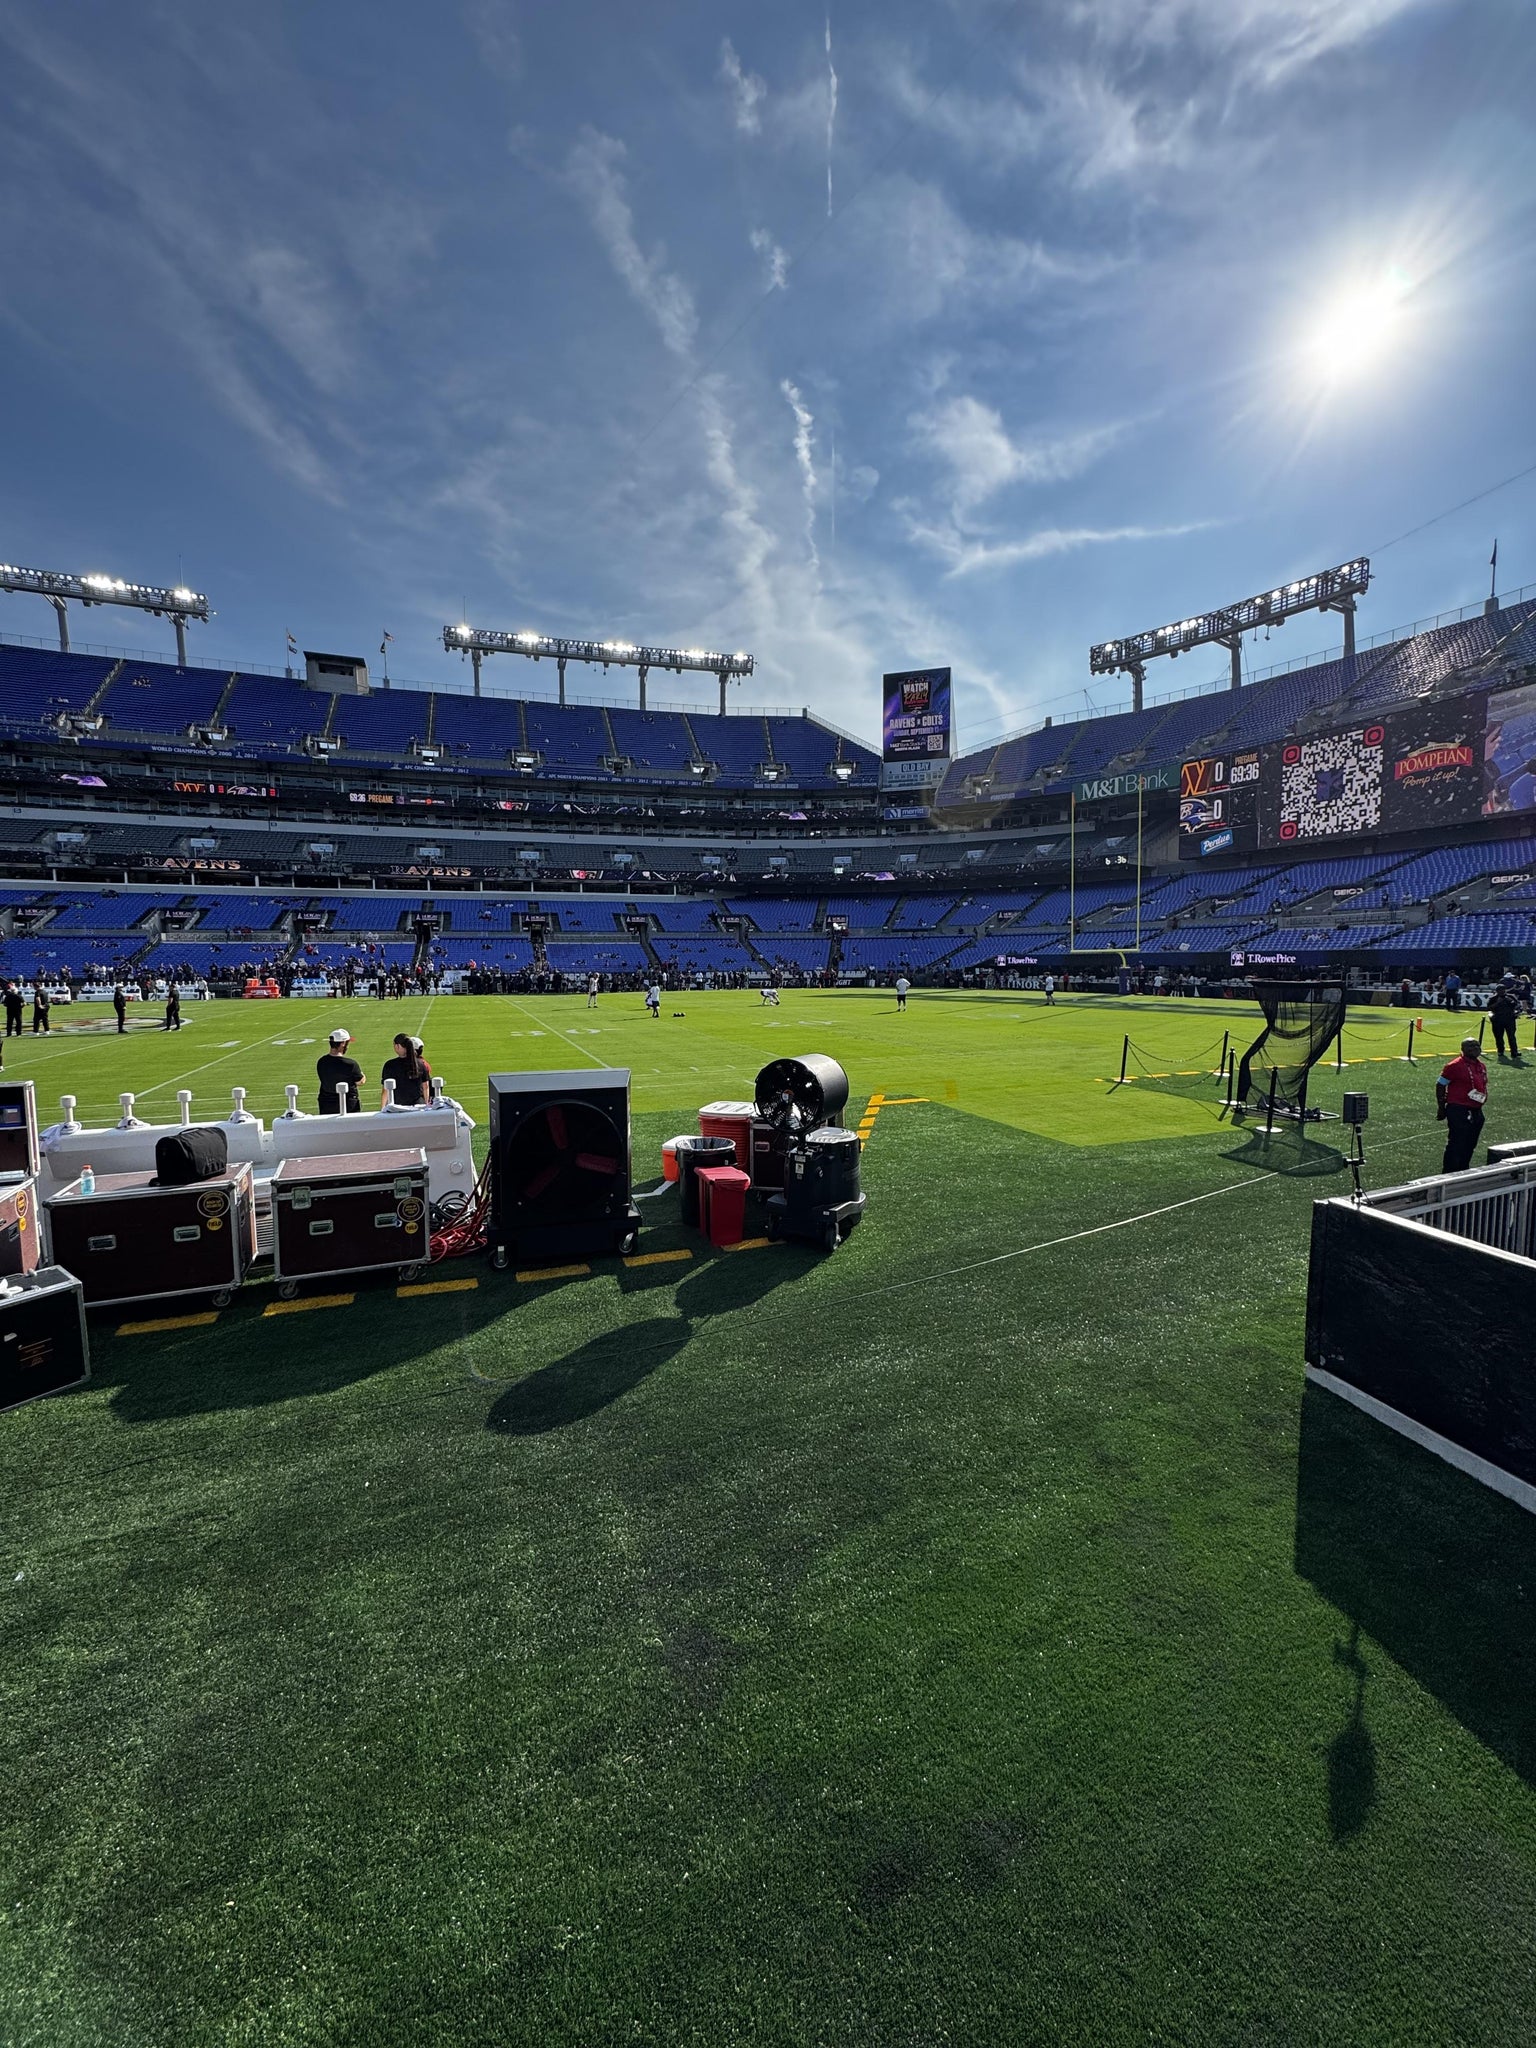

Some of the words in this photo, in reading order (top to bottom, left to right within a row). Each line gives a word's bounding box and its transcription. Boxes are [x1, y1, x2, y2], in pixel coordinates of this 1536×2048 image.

[903, 682, 929, 694] WATCH
[889, 717, 916, 729] RAVENS
[922, 714, 944, 727] COLTS
[151, 745, 173, 753] WORLD
[173, 747, 207, 756] CHAMPIONS
[1234, 752, 1258, 766] PREGAME
[1400, 748, 1467, 774] POMPEIAN
[902, 763, 916, 772] OLD
[916, 762, 930, 771] BAY
[1214, 761, 1224, 782] 0
[1230, 762, 1259, 784] 69:36
[1081, 777, 1124, 801] M&T
[1125, 769, 1168, 793] Bank
[1402, 775, 1430, 790] Pomp
[1432, 771, 1442, 781] it
[1442, 766, 1460, 783] up!
[368, 794, 394, 804] PREGAME
[1213, 799, 1222, 820] 0
[1203, 833, 1231, 851] Perdue
[142, 857, 240, 870] RAVENS
[390, 865, 471, 876] RAVENS
[1491, 874, 1530, 884] GEICO
